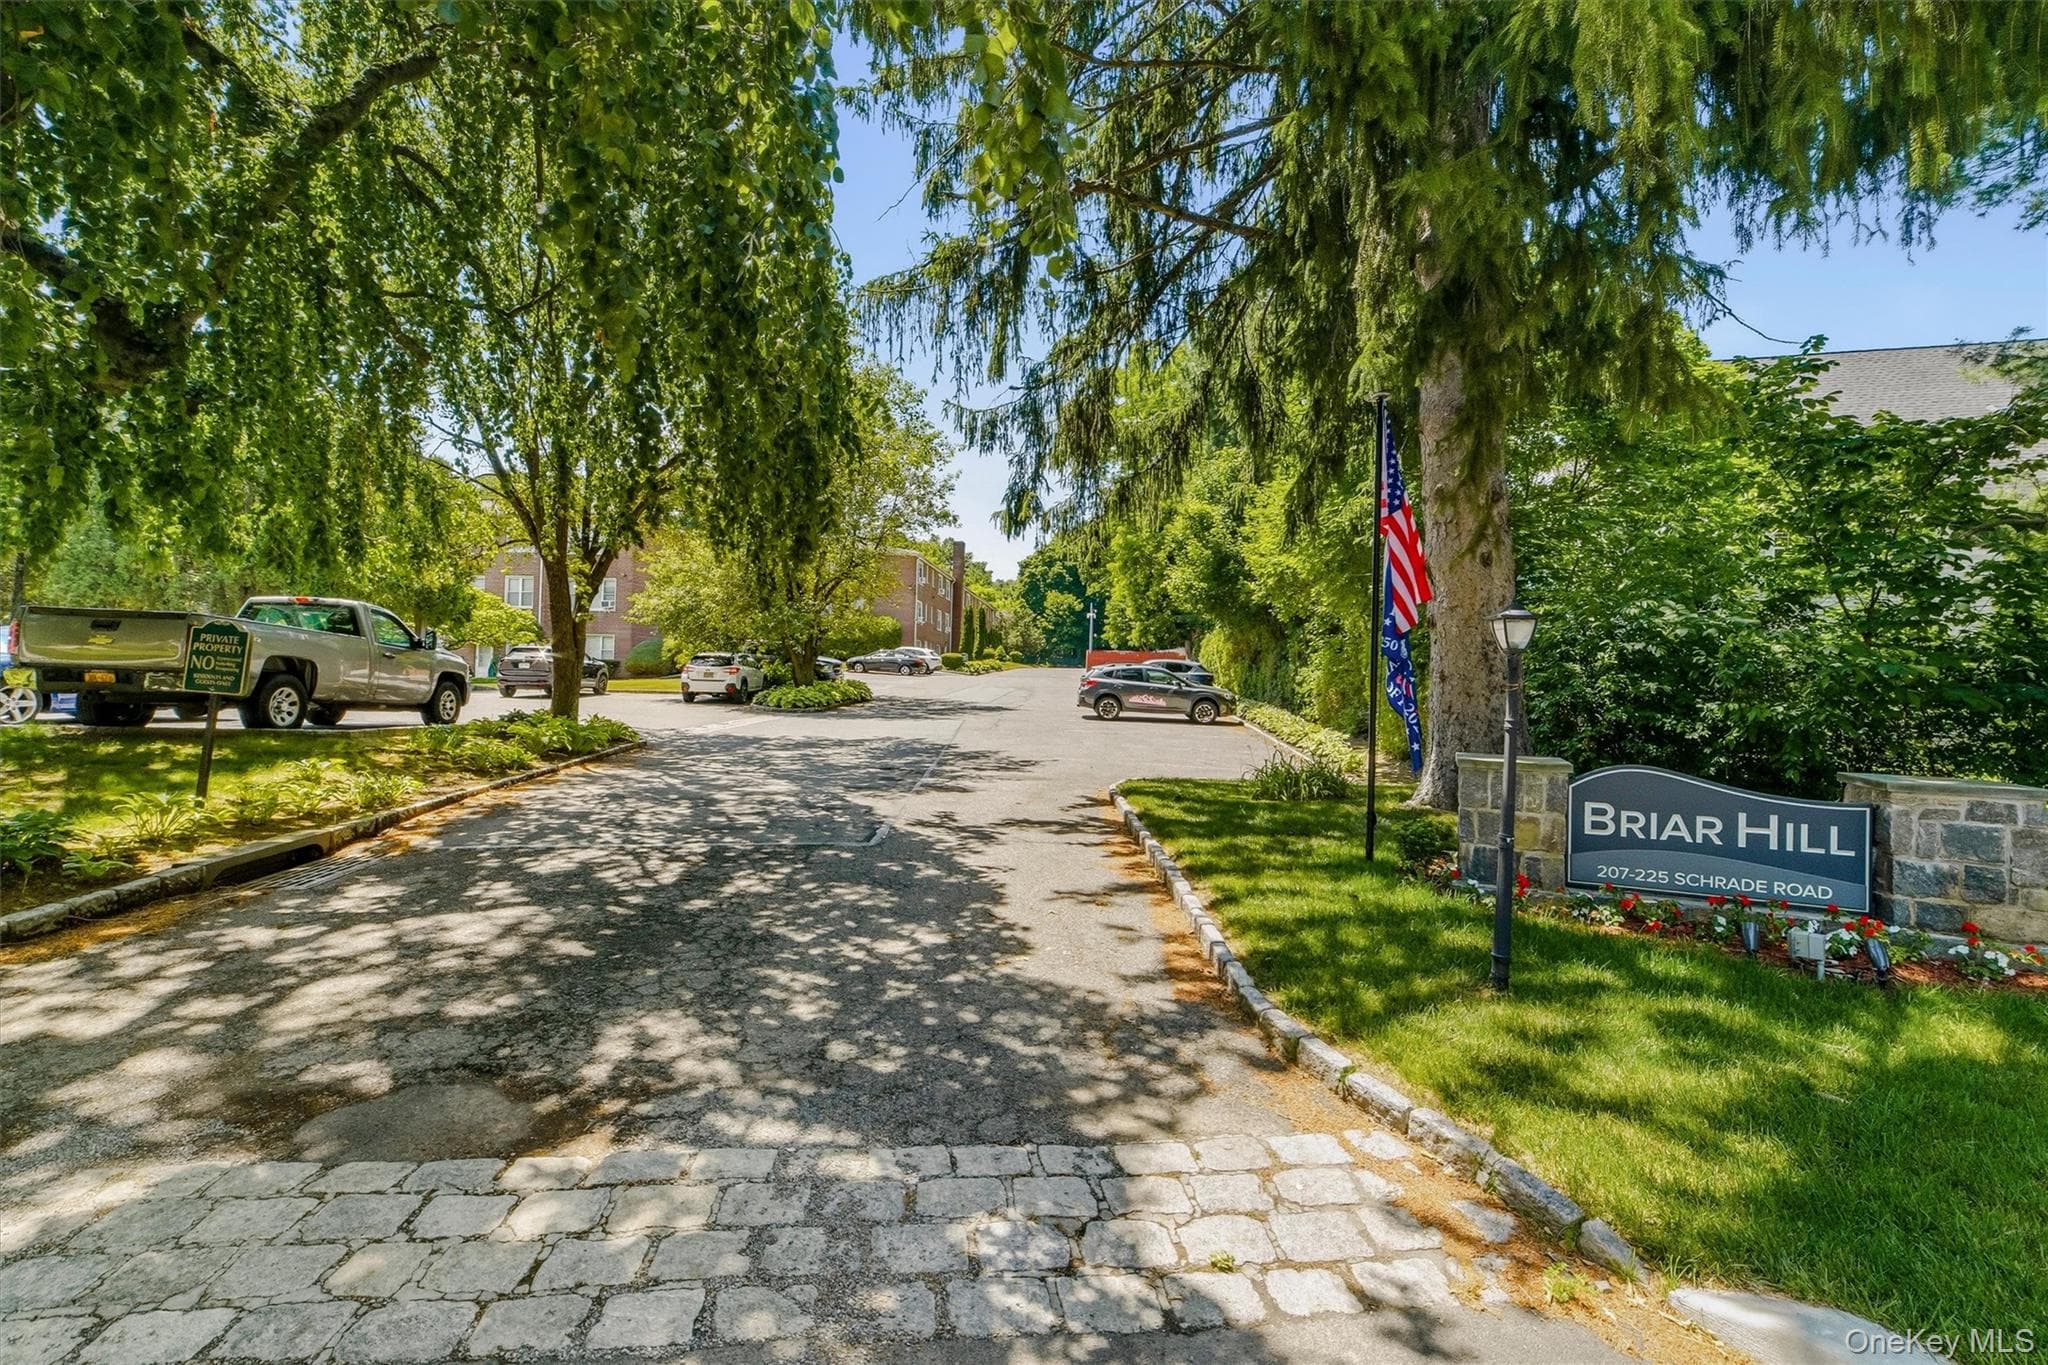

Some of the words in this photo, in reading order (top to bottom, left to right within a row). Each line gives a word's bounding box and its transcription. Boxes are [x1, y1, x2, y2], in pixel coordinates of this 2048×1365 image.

[200, 633, 240, 645] PRIVATE
[193, 642, 243, 654] PROPERTY
[190, 654, 215, 670] NO
[1584, 801, 1723, 846] BRIAR
[1738, 812, 1856, 857] HILL
[1597, 865, 1669, 884] 207-225
[1674, 872, 1768, 894] SCHRADE
[1774, 882, 1833, 900] ROAD
